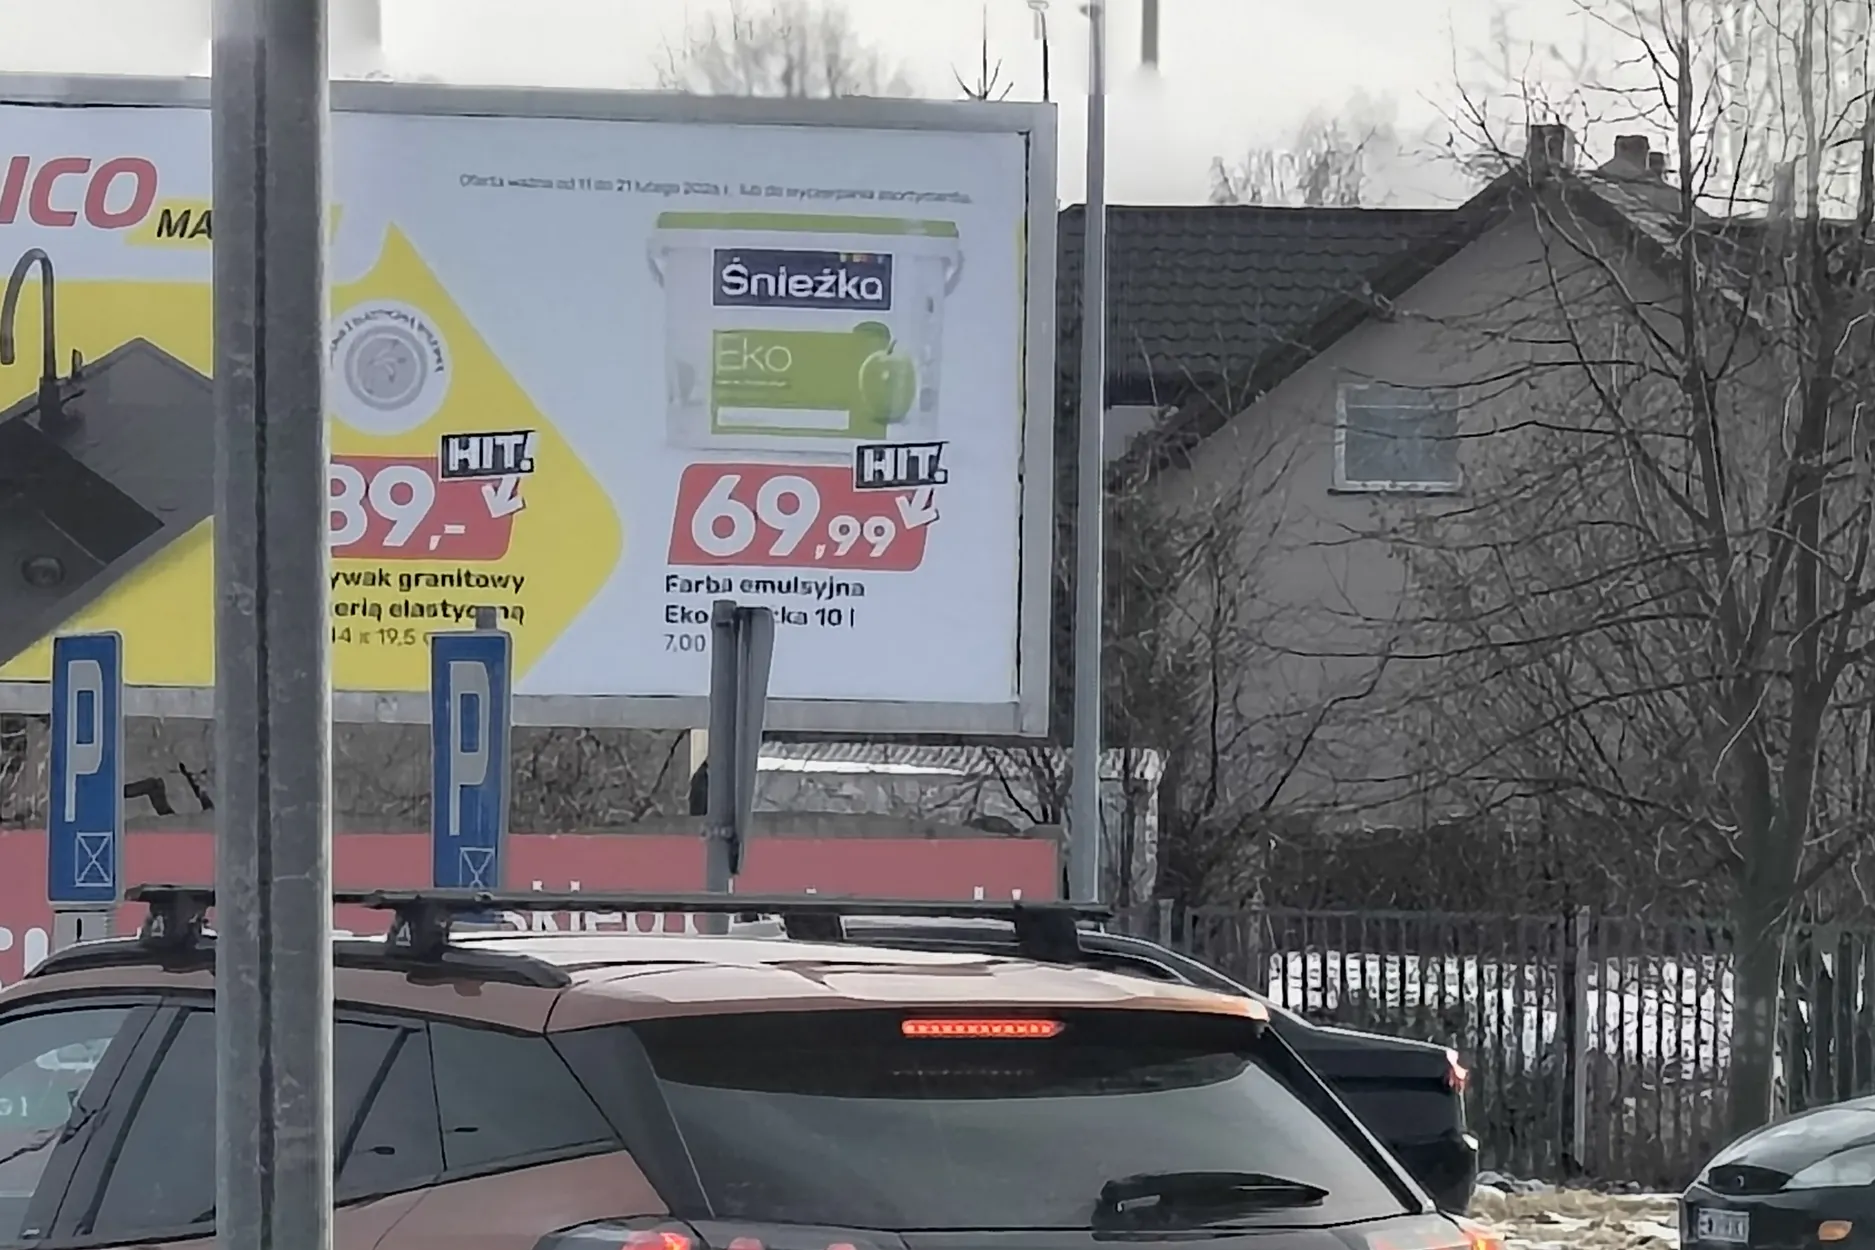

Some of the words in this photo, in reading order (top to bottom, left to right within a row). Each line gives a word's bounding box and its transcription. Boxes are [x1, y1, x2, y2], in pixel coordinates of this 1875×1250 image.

[721, 256, 884, 301] Śnieżka
[715, 333, 793, 374] Eko
[449, 431, 538, 472] HIT!
[863, 447, 948, 483] HIT!
[691, 474, 897, 560] 69,99
[331, 568, 392, 590] ywak
[398, 568, 526, 594] granitowy
[665, 575, 733, 594] Farba
[739, 576, 866, 600] emulsyjna
[330, 597, 383, 622] erią
[389, 599, 525, 626] elastycną
[665, 605, 709, 624] Eko
[814, 607, 843, 627] 10
